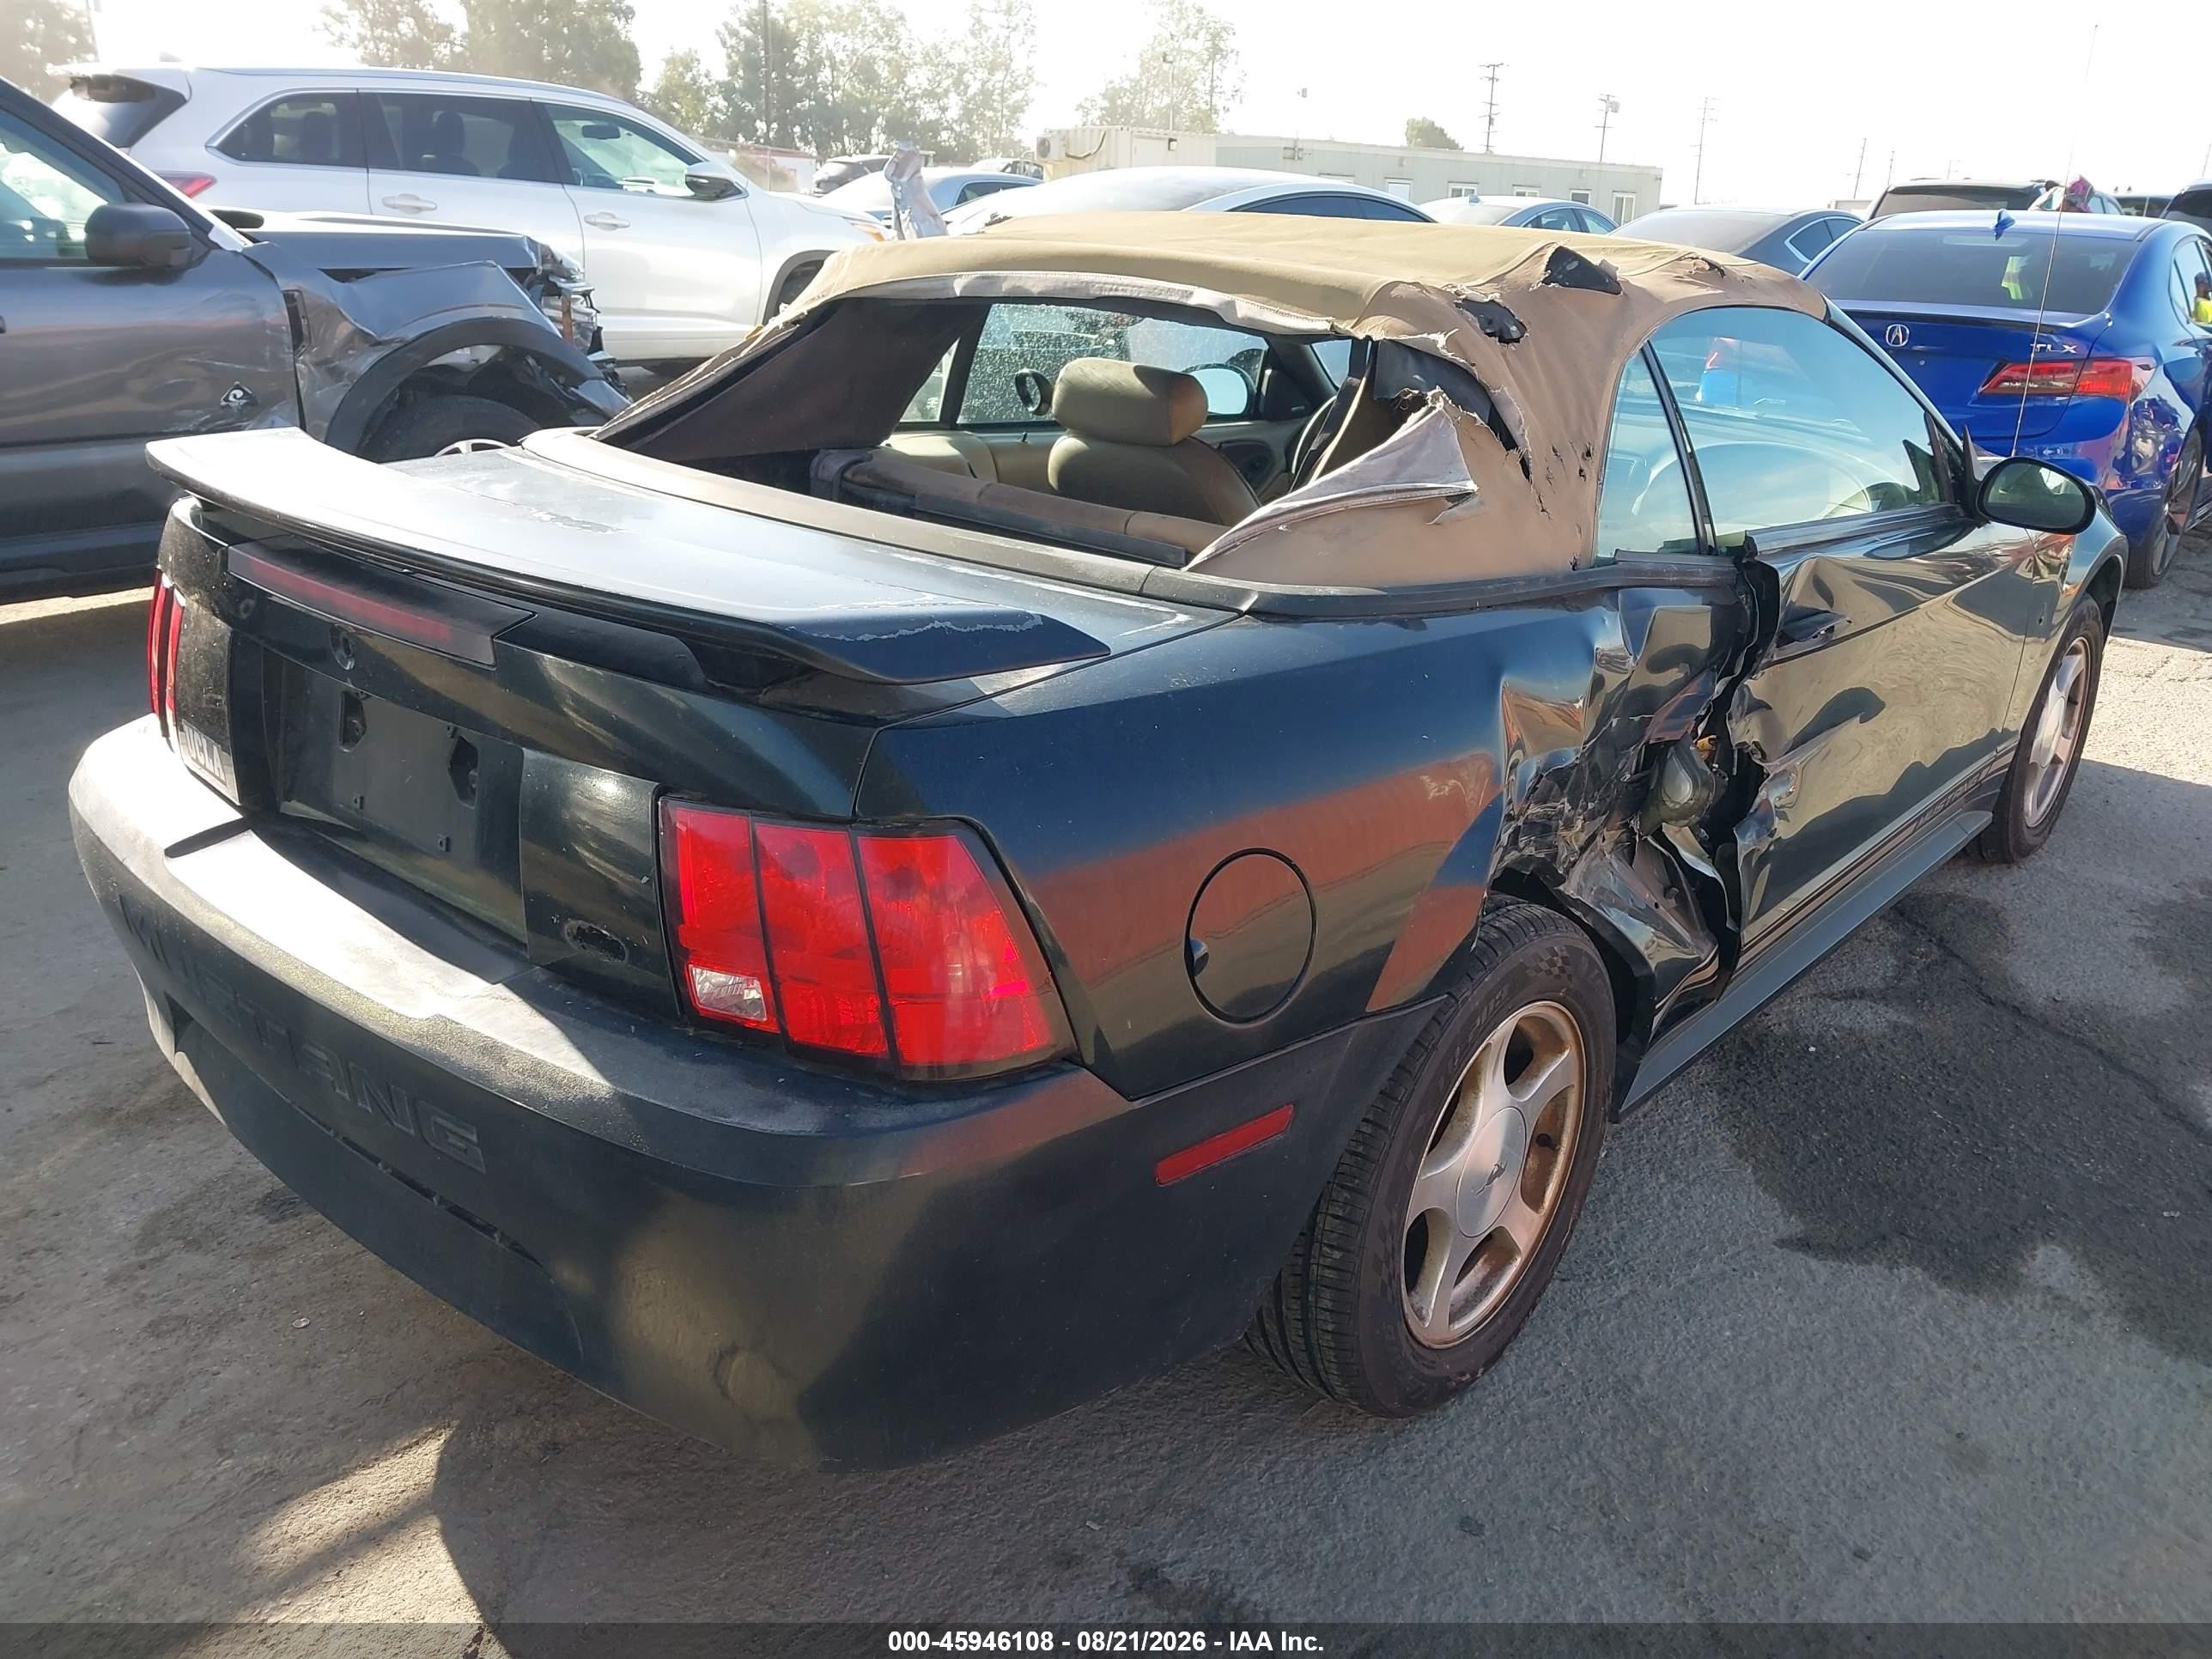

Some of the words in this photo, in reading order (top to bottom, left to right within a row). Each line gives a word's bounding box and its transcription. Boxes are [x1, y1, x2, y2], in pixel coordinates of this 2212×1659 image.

[2029, 343, 2077, 355] TLX
[183, 723, 227, 783] UCLA
[118, 893, 487, 1175] MUSTANG
